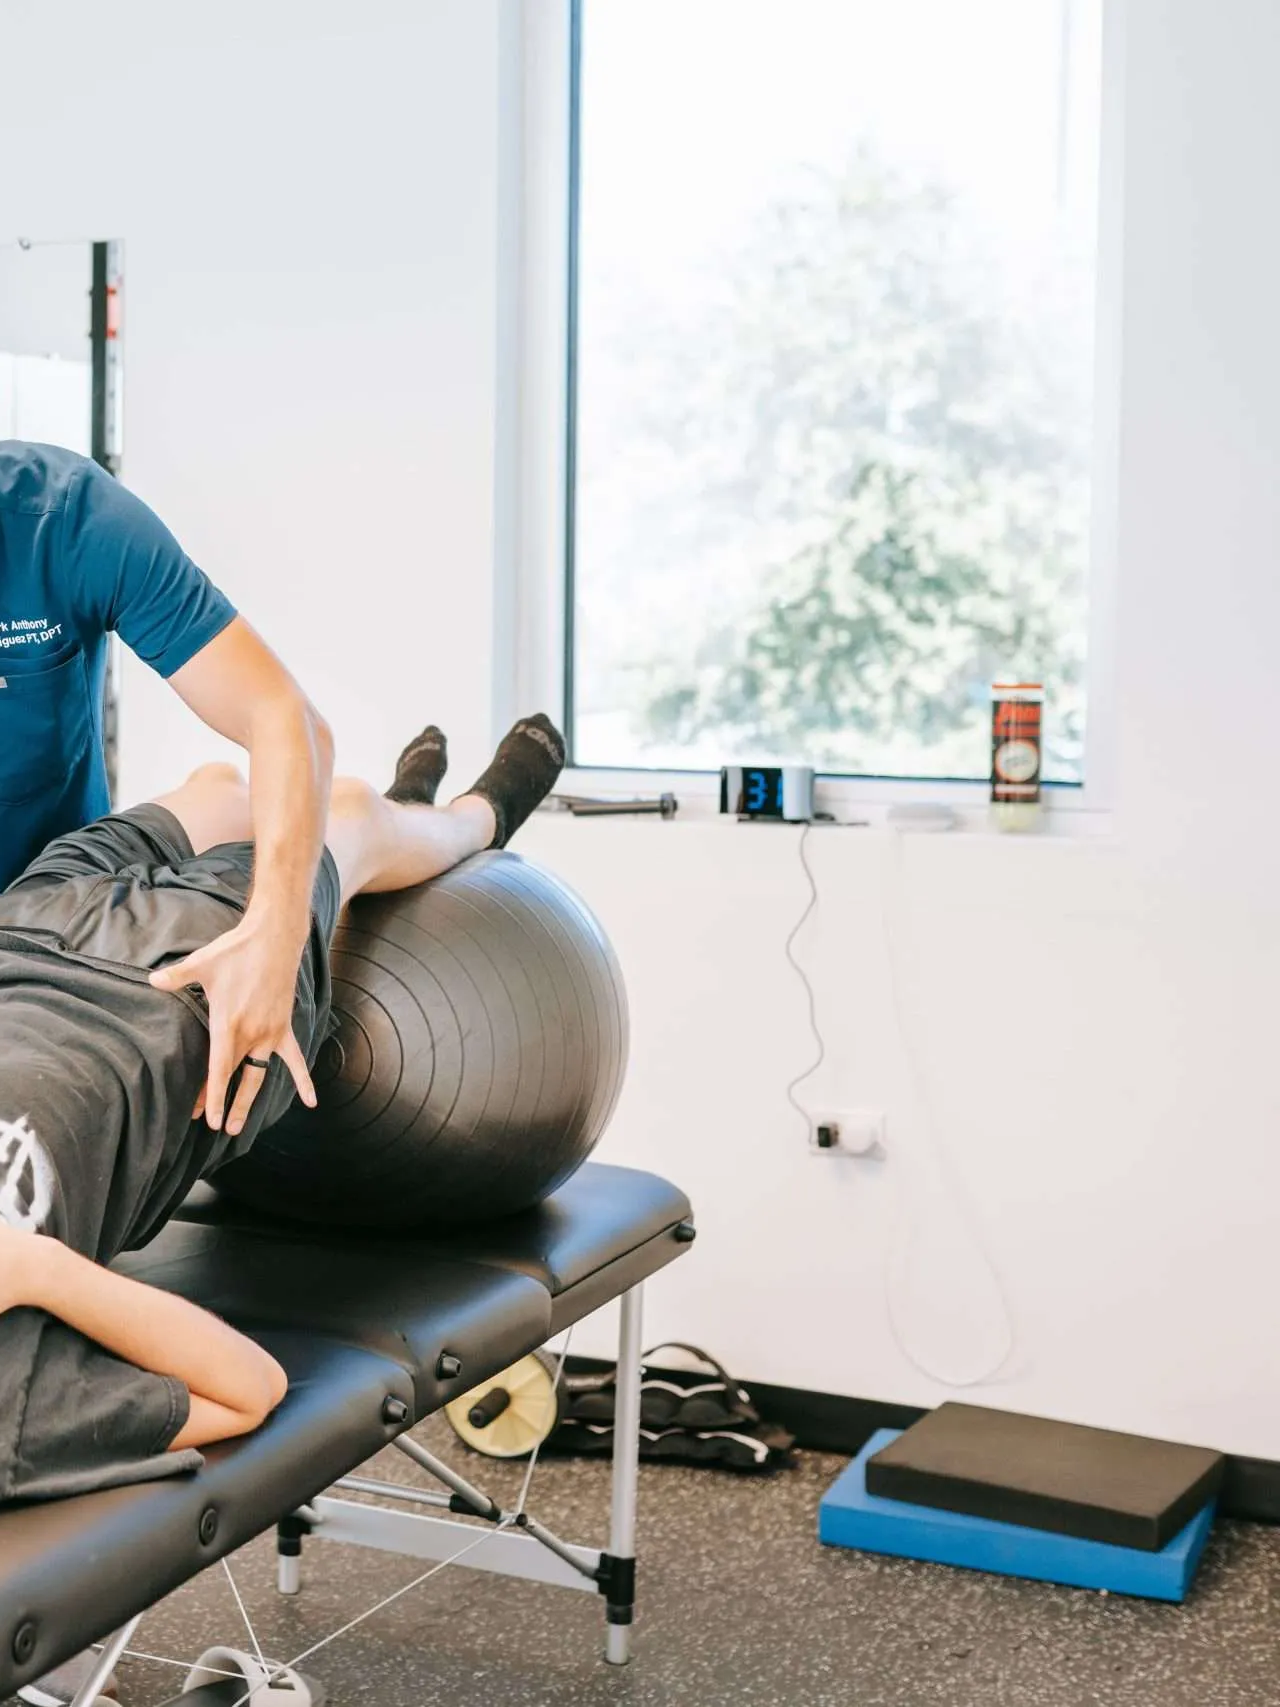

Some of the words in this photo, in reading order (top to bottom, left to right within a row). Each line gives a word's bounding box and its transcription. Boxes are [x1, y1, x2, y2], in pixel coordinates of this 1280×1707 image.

[11, 618, 48, 631] Anthony
[26, 633, 40, 645] PT,
[40, 624, 62, 641] DPT
